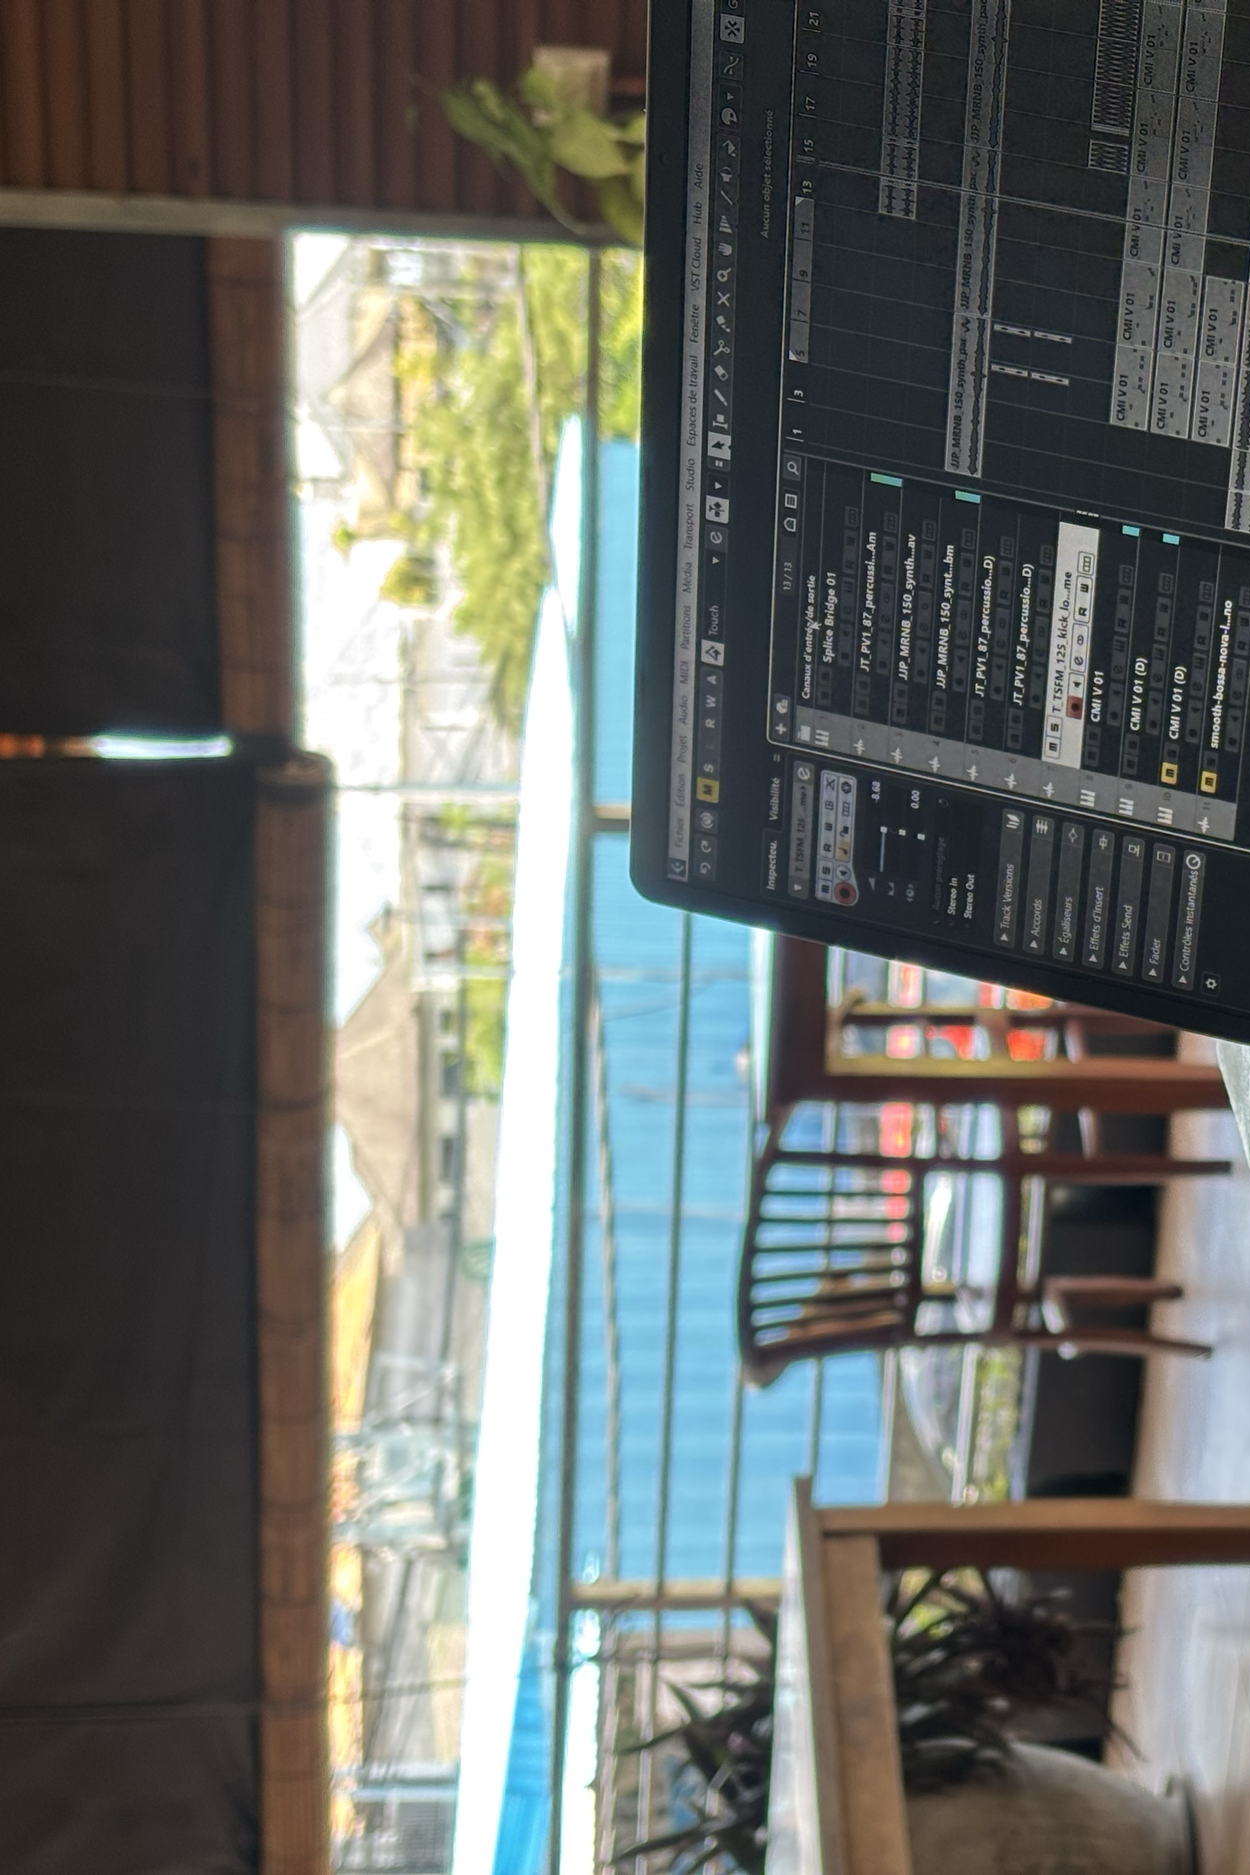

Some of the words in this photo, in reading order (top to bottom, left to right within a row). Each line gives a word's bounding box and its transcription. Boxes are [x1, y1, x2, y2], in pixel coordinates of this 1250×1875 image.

[808, 11, 820, 26] 21
[1146, 34, 1156, 48] 01
[1189, 41, 1198, 55] 01
[806, 53, 817, 68] 19
[1143, 63, 1154, 85] CMI
[1185, 70, 1196, 93] CMI
[805, 96, 816, 111] 17
[762, 109, 774, 171] sélectionné
[1139, 123, 1148, 136] 01
[1182, 130, 1191, 144] 01
[803, 139, 814, 153] 15
[1136, 150, 1146, 172] CMI
[1178, 158, 1189, 180] CMI
[692, 163, 704, 190] Aide
[761, 174, 774, 201] objet
[802, 180, 812, 194] 13
[691, 202, 703, 224] Hub
[760, 204, 771, 238] Aucun
[1132, 208, 1141, 221] 01
[1174, 216, 1183, 228] 01
[690, 237, 702, 269] Cloud
[1129, 236, 1139, 257] CMI
[1171, 243, 1181, 264] CMI
[690, 272, 700, 292] VST
[1126, 292, 1135, 305] 01
[1167, 300, 1176, 313] 01
[688, 304, 701, 344] Fenêtre
[1209, 308, 1218, 321] 01
[1123, 318, 1133, 340] CMI
[1164, 326, 1174, 348] CMI
[1205, 335, 1216, 356] CMI
[688, 355, 698, 388] travail
[1119, 374, 1128, 387] 01
[687, 390, 698, 404] de
[1159, 382, 1169, 395] 01
[1201, 390, 1210, 403] 01
[1116, 400, 1126, 421] CMI
[1157, 408, 1167, 429] CMI
[686, 406, 699, 446] Espaces
[1198, 416, 1208, 437] CMI
[685, 458, 696, 492] Studio
[684, 503, 696, 550] Transport
[682, 562, 694, 593] Média
[783, 562, 792, 572] 13
[783, 581, 792, 591] 13
[806, 575, 816, 604] sortie
[826, 572, 836, 585] 01
[824, 589, 838, 626] Bridge
[680, 605, 692, 650] Partitions
[708, 605, 720, 636] Touch
[822, 629, 835, 663] Splice
[679, 660, 690, 684] MIDI
[1093, 670, 1104, 684] 01
[1135, 657, 1147, 676] (D)
[1174, 666, 1186, 685] (D)
[706, 675, 718, 685] A
[802, 664, 812, 699] Canaux
[1092, 686, 1102, 696] V
[1133, 679, 1144, 693] 01
[706, 694, 716, 708] W
[1132, 695, 1142, 705] V
[1172, 687, 1184, 702] 01
[678, 696, 689, 725] Audio
[1090, 698, 1102, 722] CMI
[1130, 707, 1142, 731] CMI
[1171, 703, 1182, 713] V
[706, 718, 716, 728] R
[1169, 716, 1180, 740] CMI
[676, 736, 688, 763] Projet
[704, 764, 714, 772] S
[674, 774, 686, 807] Édition
[703, 784, 712, 796] M
[769, 777, 780, 820] Visibilité
[872, 781, 881, 803] -8.68
[911, 790, 920, 809] 0.00
[674, 818, 685, 848] Fichier
[766, 840, 778, 890] Inspecteu.
[950, 877, 958, 886] In
[965, 873, 976, 890] Out
[1002, 864, 1015, 902] Versions
[947, 888, 958, 915] Stereo
[964, 892, 974, 919] Stereo
[1091, 887, 1104, 922] d'Insert
[1185, 870, 1199, 924] instantanés
[1000, 904, 1012, 928] Track
[1030, 899, 1042, 937] Accords
[1058, 896, 1073, 944] Égaliseurs
[1122, 904, 1133, 929] Send
[1089, 925, 1101, 950] Effets
[1119, 931, 1131, 958] Effets
[1150, 938, 1161, 965] Fader
[1179, 927, 1193, 972] Contrôles
